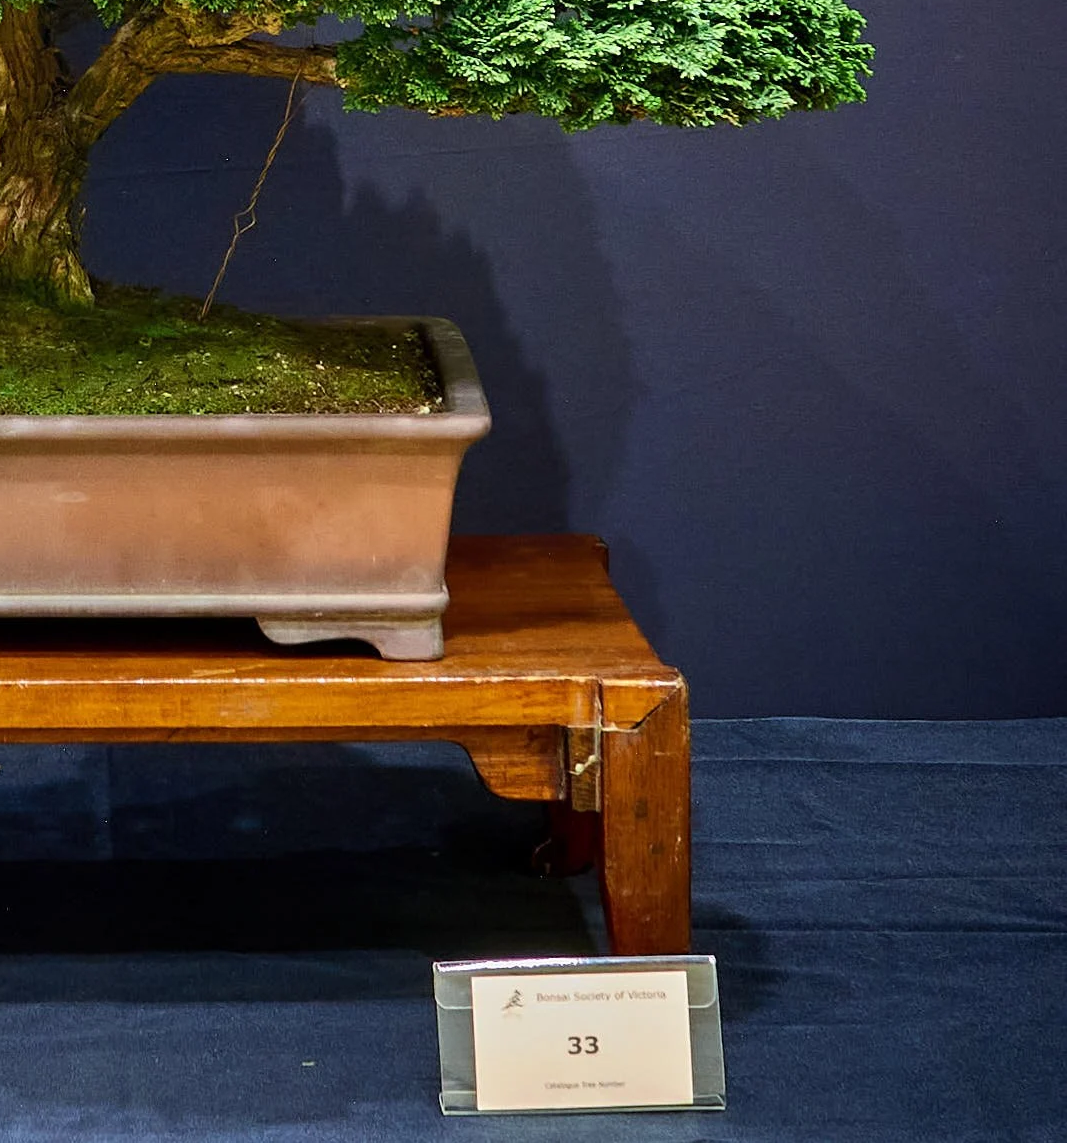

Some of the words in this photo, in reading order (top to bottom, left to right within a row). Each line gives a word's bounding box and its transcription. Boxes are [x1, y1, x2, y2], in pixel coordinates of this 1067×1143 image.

[536, 992, 570, 1002] Bonsai
[573, 991, 611, 1003] Society
[614, 990, 625, 1001] of
[628, 990, 667, 1000] Victoria
[567, 1035, 599, 1055] 33
